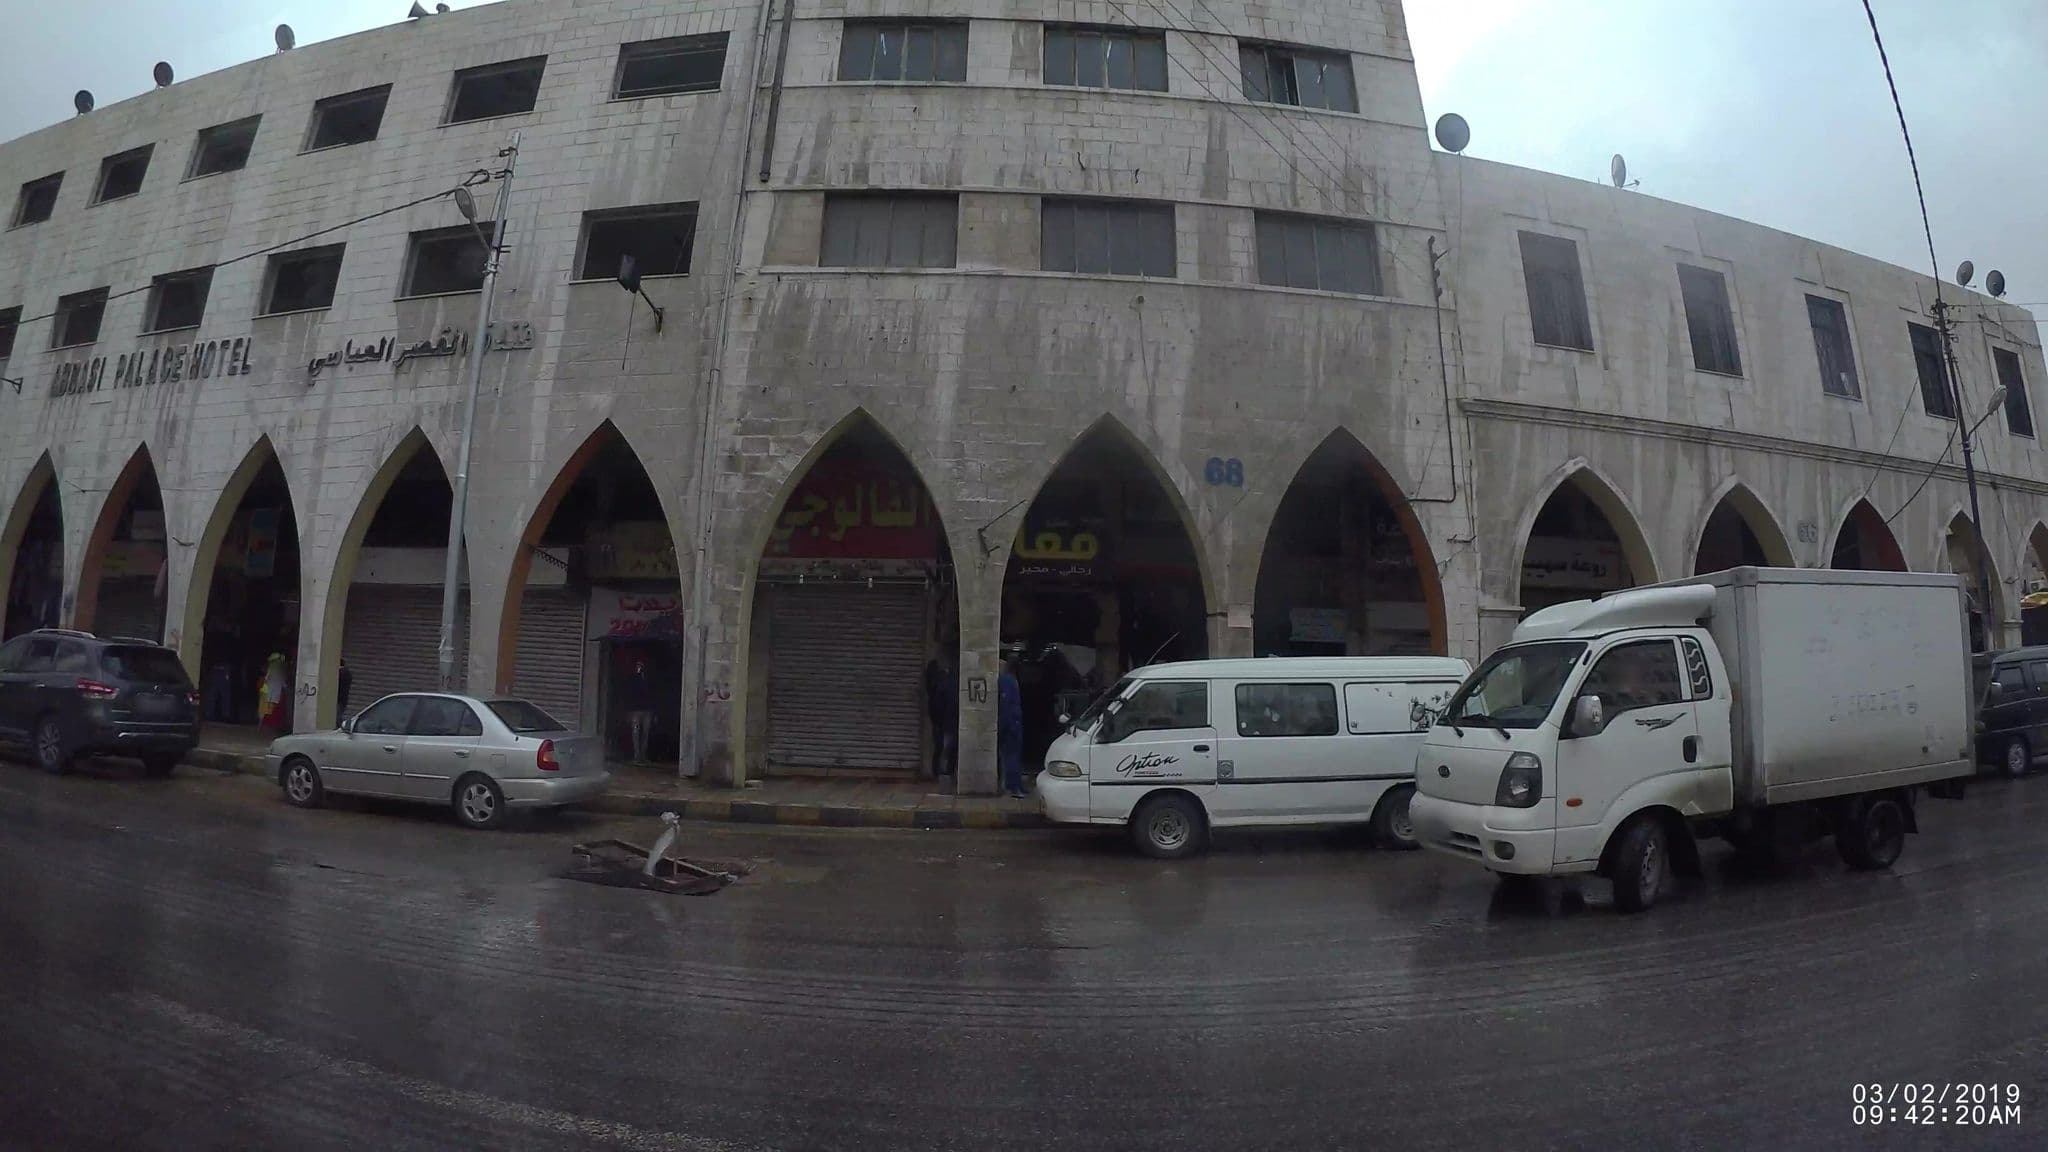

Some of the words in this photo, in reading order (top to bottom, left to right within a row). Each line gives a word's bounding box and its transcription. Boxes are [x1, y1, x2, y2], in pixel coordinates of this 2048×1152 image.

[114, 345, 188, 390] PALACE
[189, 337, 253, 381] HOTEL
[307, 335, 396, 387] العباسي
[392, 326, 470, 368] القصر
[1205, 456, 1244, 488] 68
